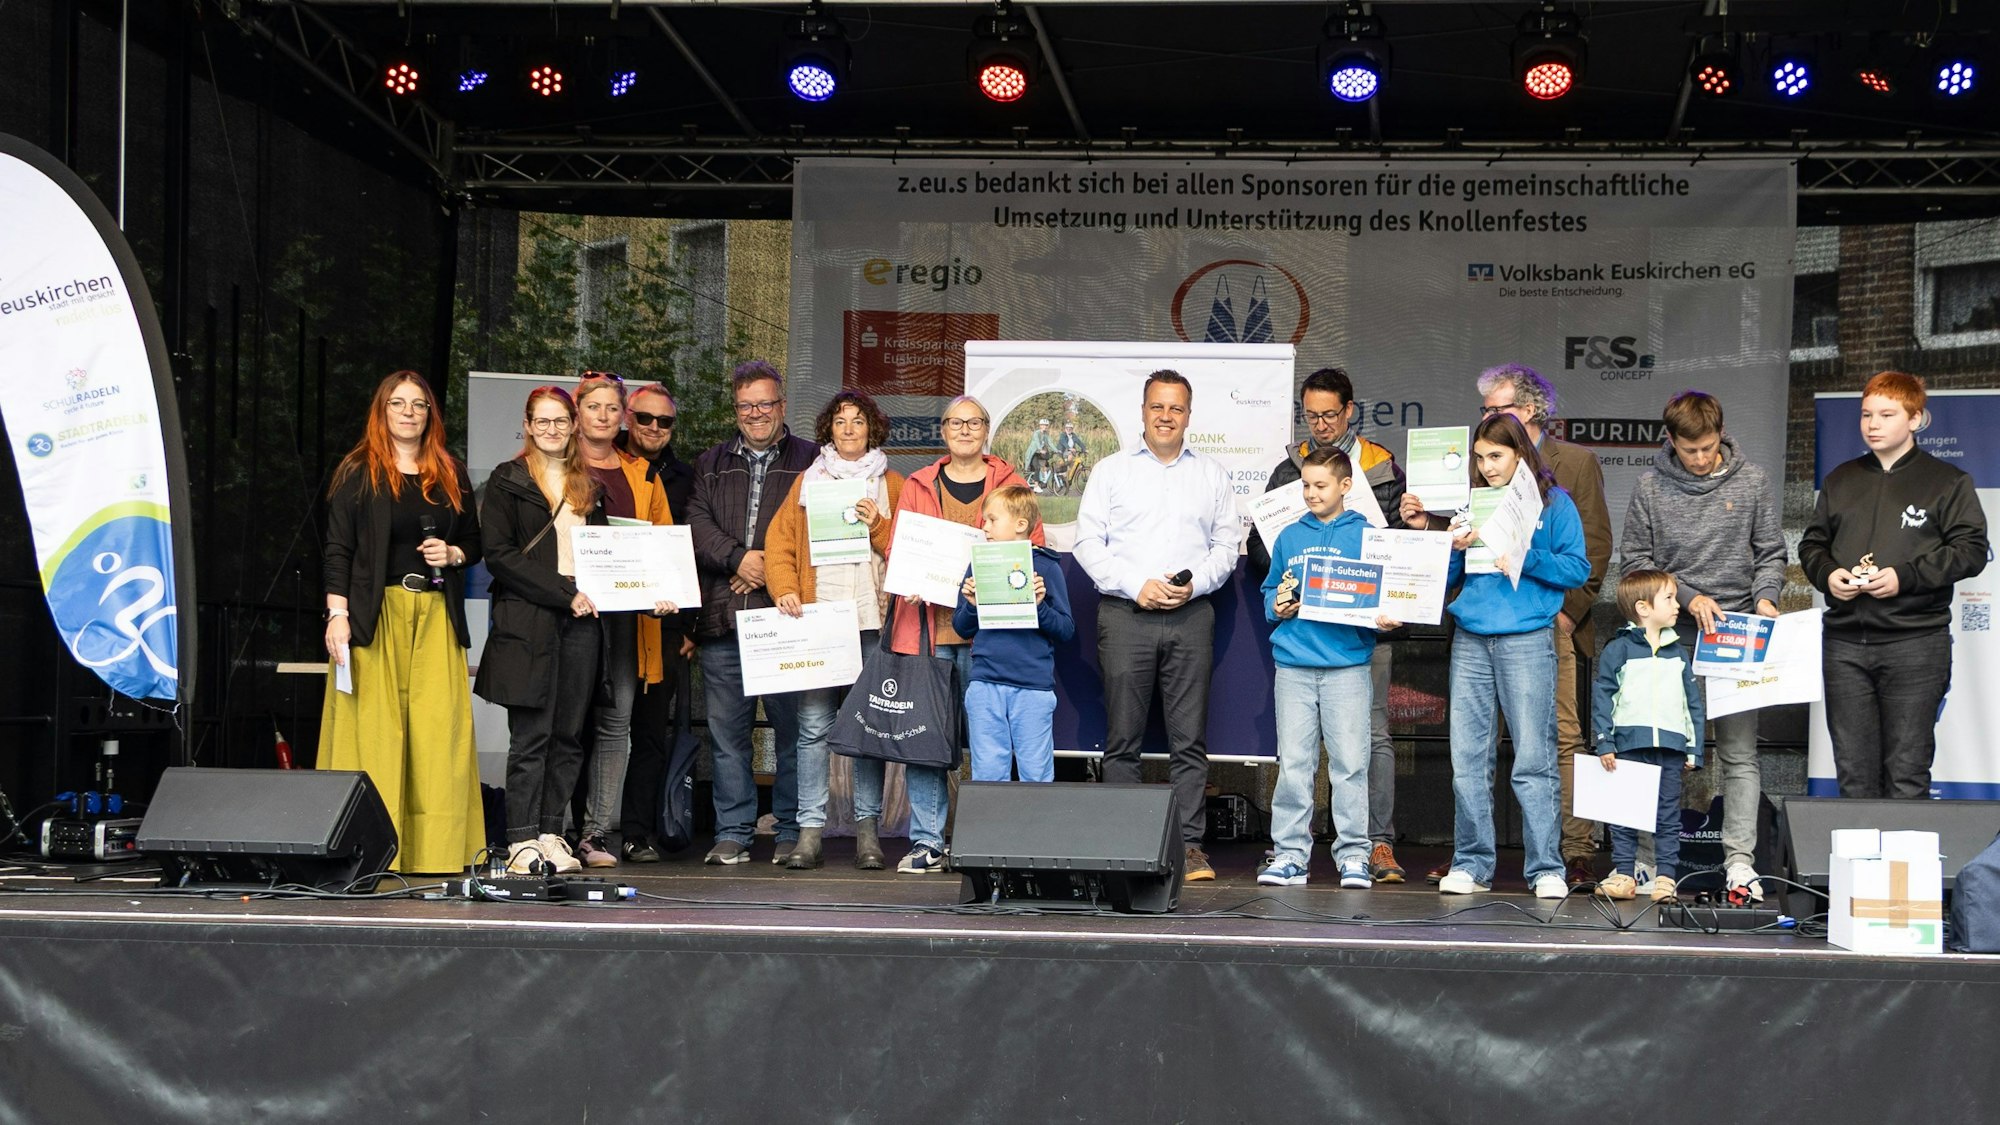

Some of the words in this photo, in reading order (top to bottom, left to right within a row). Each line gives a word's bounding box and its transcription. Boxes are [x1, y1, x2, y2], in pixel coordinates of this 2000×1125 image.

[898, 176, 967, 193] z.eu.s
[975, 171, 1072, 193] bedankt
[1078, 172, 1125, 194] sich
[1132, 172, 1168, 194] bei
[1176, 173, 1234, 195] allen
[1242, 173, 1367, 200] Sponsoren
[1375, 173, 1412, 196] für
[1418, 174, 1455, 196] die
[1463, 173, 1689, 201] gemeinschaftliche
[994, 206, 1127, 233] Umsetzung
[1135, 208, 1178, 229] und
[1186, 208, 1362, 236] Unterstützung
[1369, 208, 1411, 231] des
[1418, 209, 1587, 232] Knollenfestes
[863, 258, 982, 291] eregio
[1499, 264, 1604, 282] Volksbank
[1611, 262, 1721, 280] Euskirchen
[1728, 262, 1756, 279] eG
[1, 275, 113, 315] euskirchen
[1499, 287, 1516, 297] Die
[1519, 286, 1549, 297] beste
[1552, 286, 1624, 298] Entscheidung.
[49, 300, 69, 312] stadt
[71, 296, 86, 306] mit
[88, 289, 116, 302] gesicht
[884, 353, 952, 367] Euskirchen
[1600, 371, 1653, 381] CONCEPT
[43, 385, 120, 411] SCHULRADELN
[57, 413, 149, 442] STADTRADELN
[1189, 433, 1226, 444] DANK
[1917, 436, 1957, 447] Langen
[1237, 470, 1268, 481] 2026
[580, 548, 613, 556] Urkunde
[1365, 552, 1392, 561] Urkunde
[1311, 563, 1377, 578] Waren-Gutschein
[614, 581, 640, 589] 200,00
[1715, 620, 1768, 634] ren-Gutschein
[744, 630, 778, 640] Urkunde
[779, 661, 805, 671] 200,00
[807, 660, 825, 668] Euro
[1761, 676, 1779, 684] Euro
